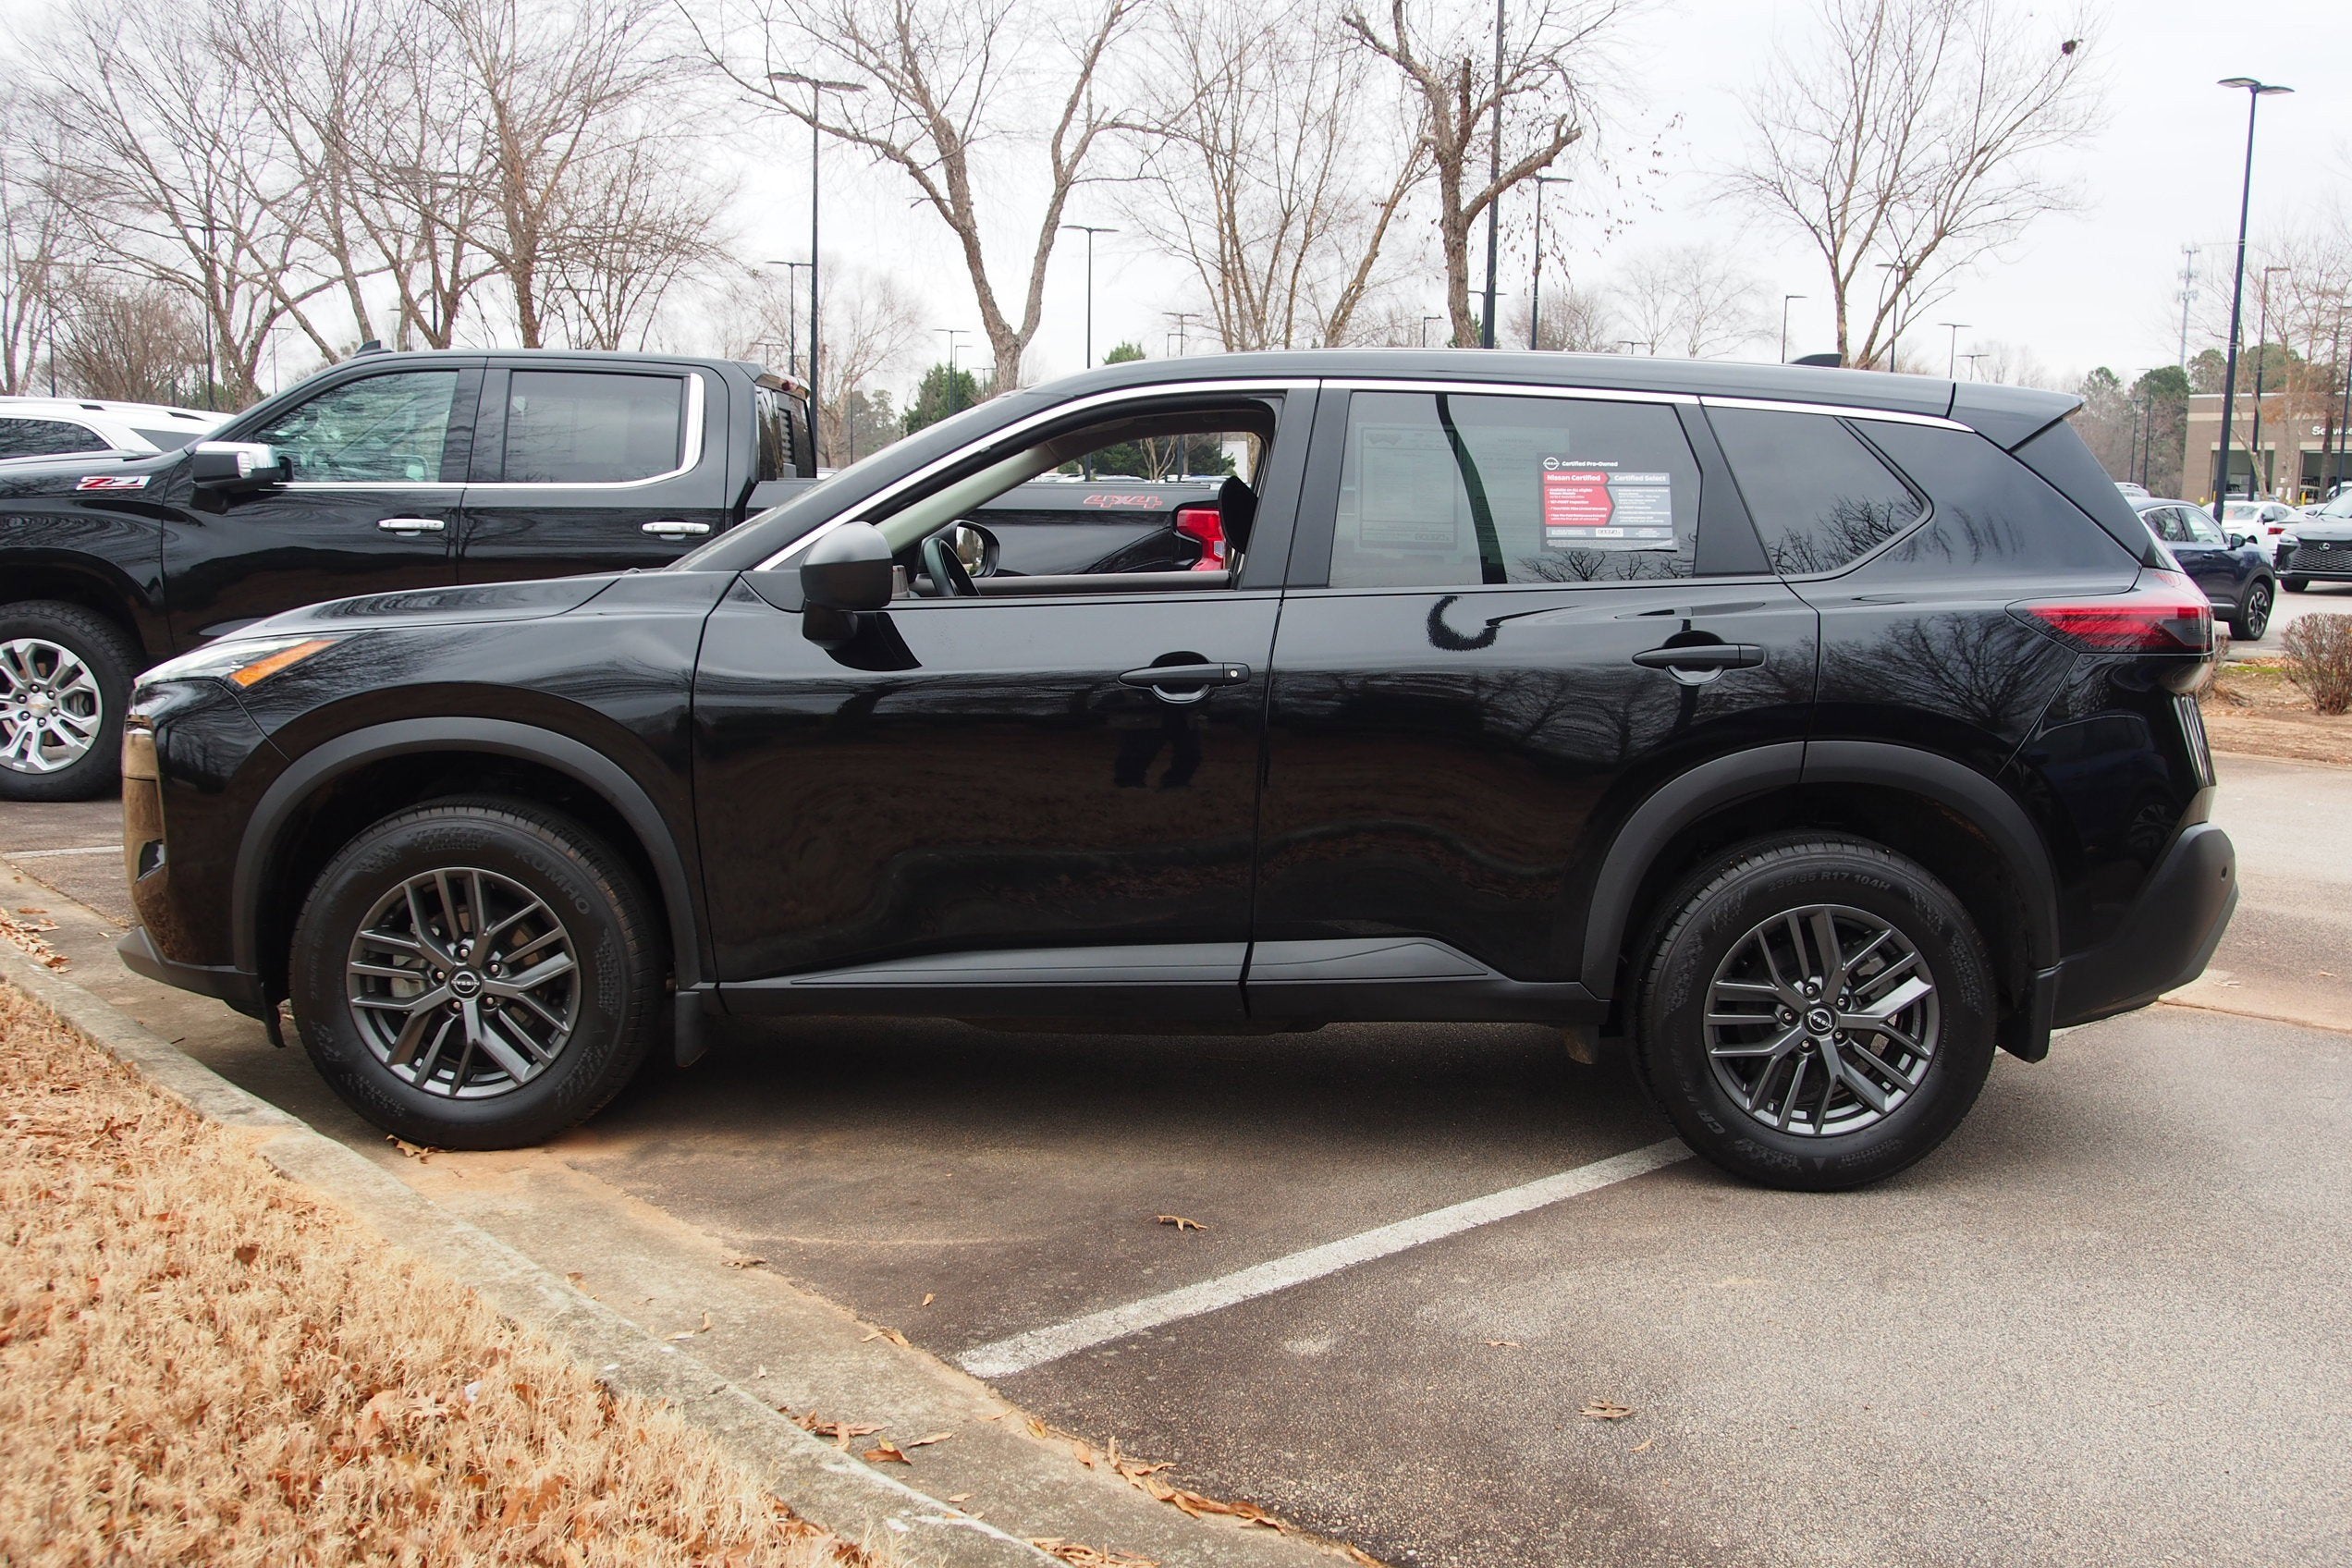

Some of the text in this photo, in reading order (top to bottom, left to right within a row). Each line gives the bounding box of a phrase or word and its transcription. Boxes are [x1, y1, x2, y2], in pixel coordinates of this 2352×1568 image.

[2311, 425, 2352, 435] Sevie
[76, 475, 152, 491] Z71
[514, 850, 592, 915] KUMHO
[1768, 871, 1892, 892] 235/65 R17 104H
